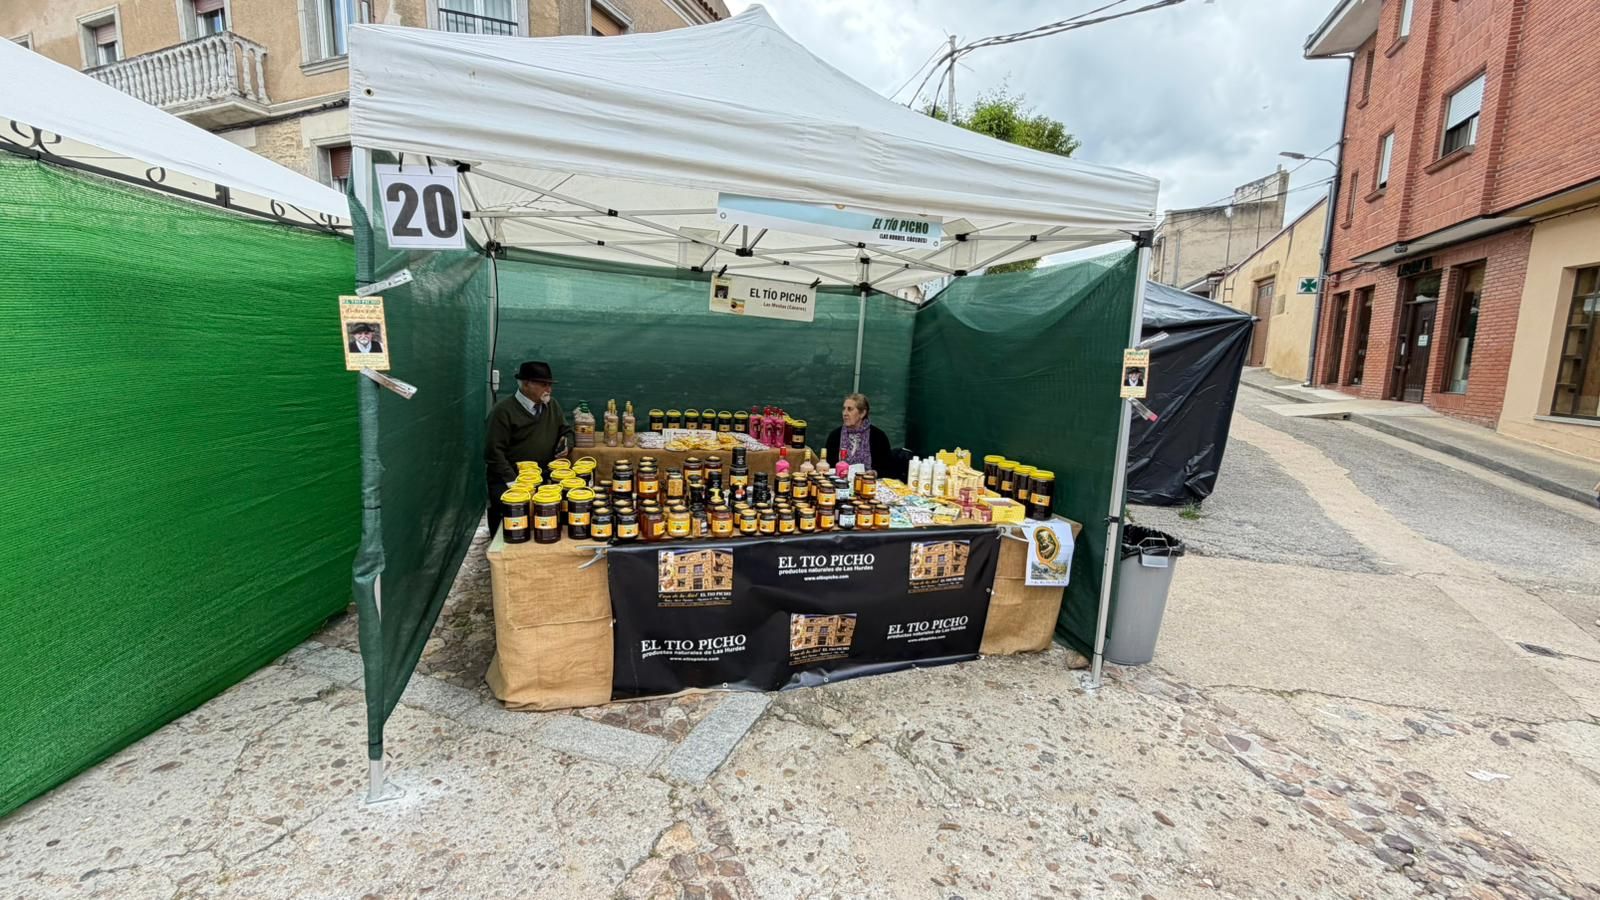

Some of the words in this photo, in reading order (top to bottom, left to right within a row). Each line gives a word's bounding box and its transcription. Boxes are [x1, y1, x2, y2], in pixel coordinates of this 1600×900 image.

[386, 182, 458, 239] 20
[872, 217, 883, 230] EL
[883, 217, 899, 231] TÍO
[899, 220, 929, 235] PICHO
[749, 287, 761, 299] EL
[763, 287, 778, 301] TÍO
[779, 291, 808, 304] PICHO
[778, 556, 797, 569] EL
[800, 555, 827, 567] TIO
[830, 553, 875, 567] PICHO
[778, 568, 808, 576] productos
[887, 624, 905, 635] EL
[907, 621, 929, 633] TIO
[932, 615, 969, 630] PICHO
[641, 640, 661, 653] EL
[664, 640, 694, 650] TIO
[698, 634, 746, 650] PICHO
[642, 650, 673, 659] productos
[724, 645, 746, 653] Hurdes
